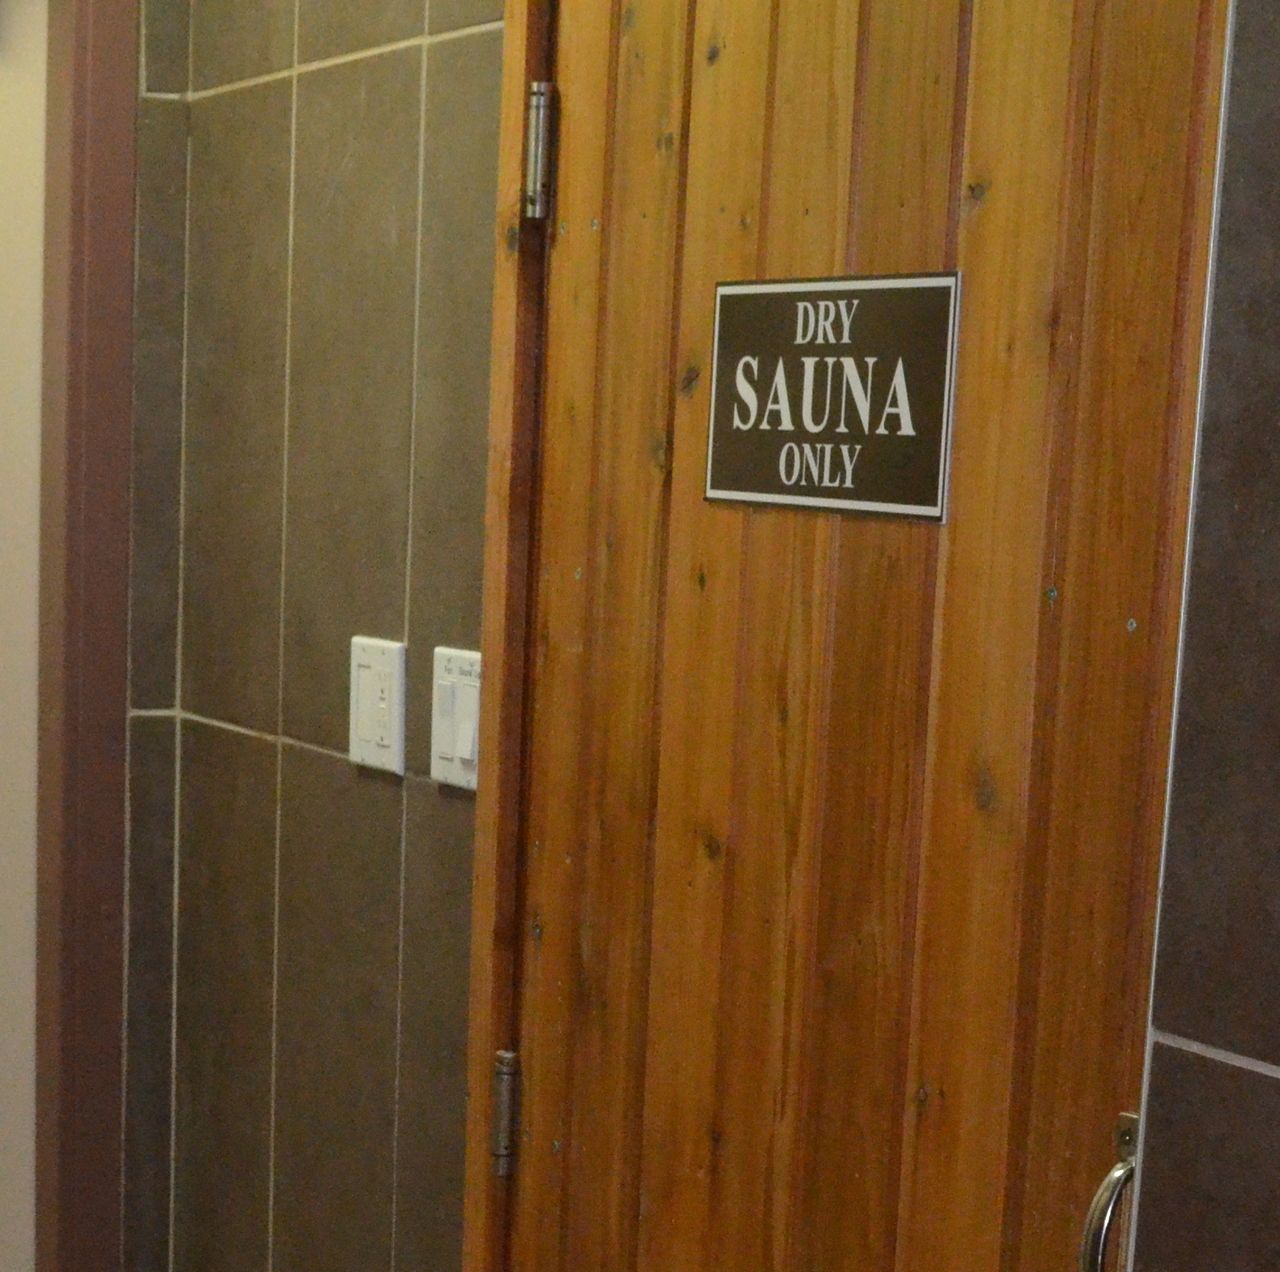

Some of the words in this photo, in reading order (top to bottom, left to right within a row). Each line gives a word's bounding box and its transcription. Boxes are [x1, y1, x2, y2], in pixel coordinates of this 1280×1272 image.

[793, 299, 860, 345] DRY
[732, 355, 916, 436] SAUNA
[778, 442, 862, 488] ONLY
